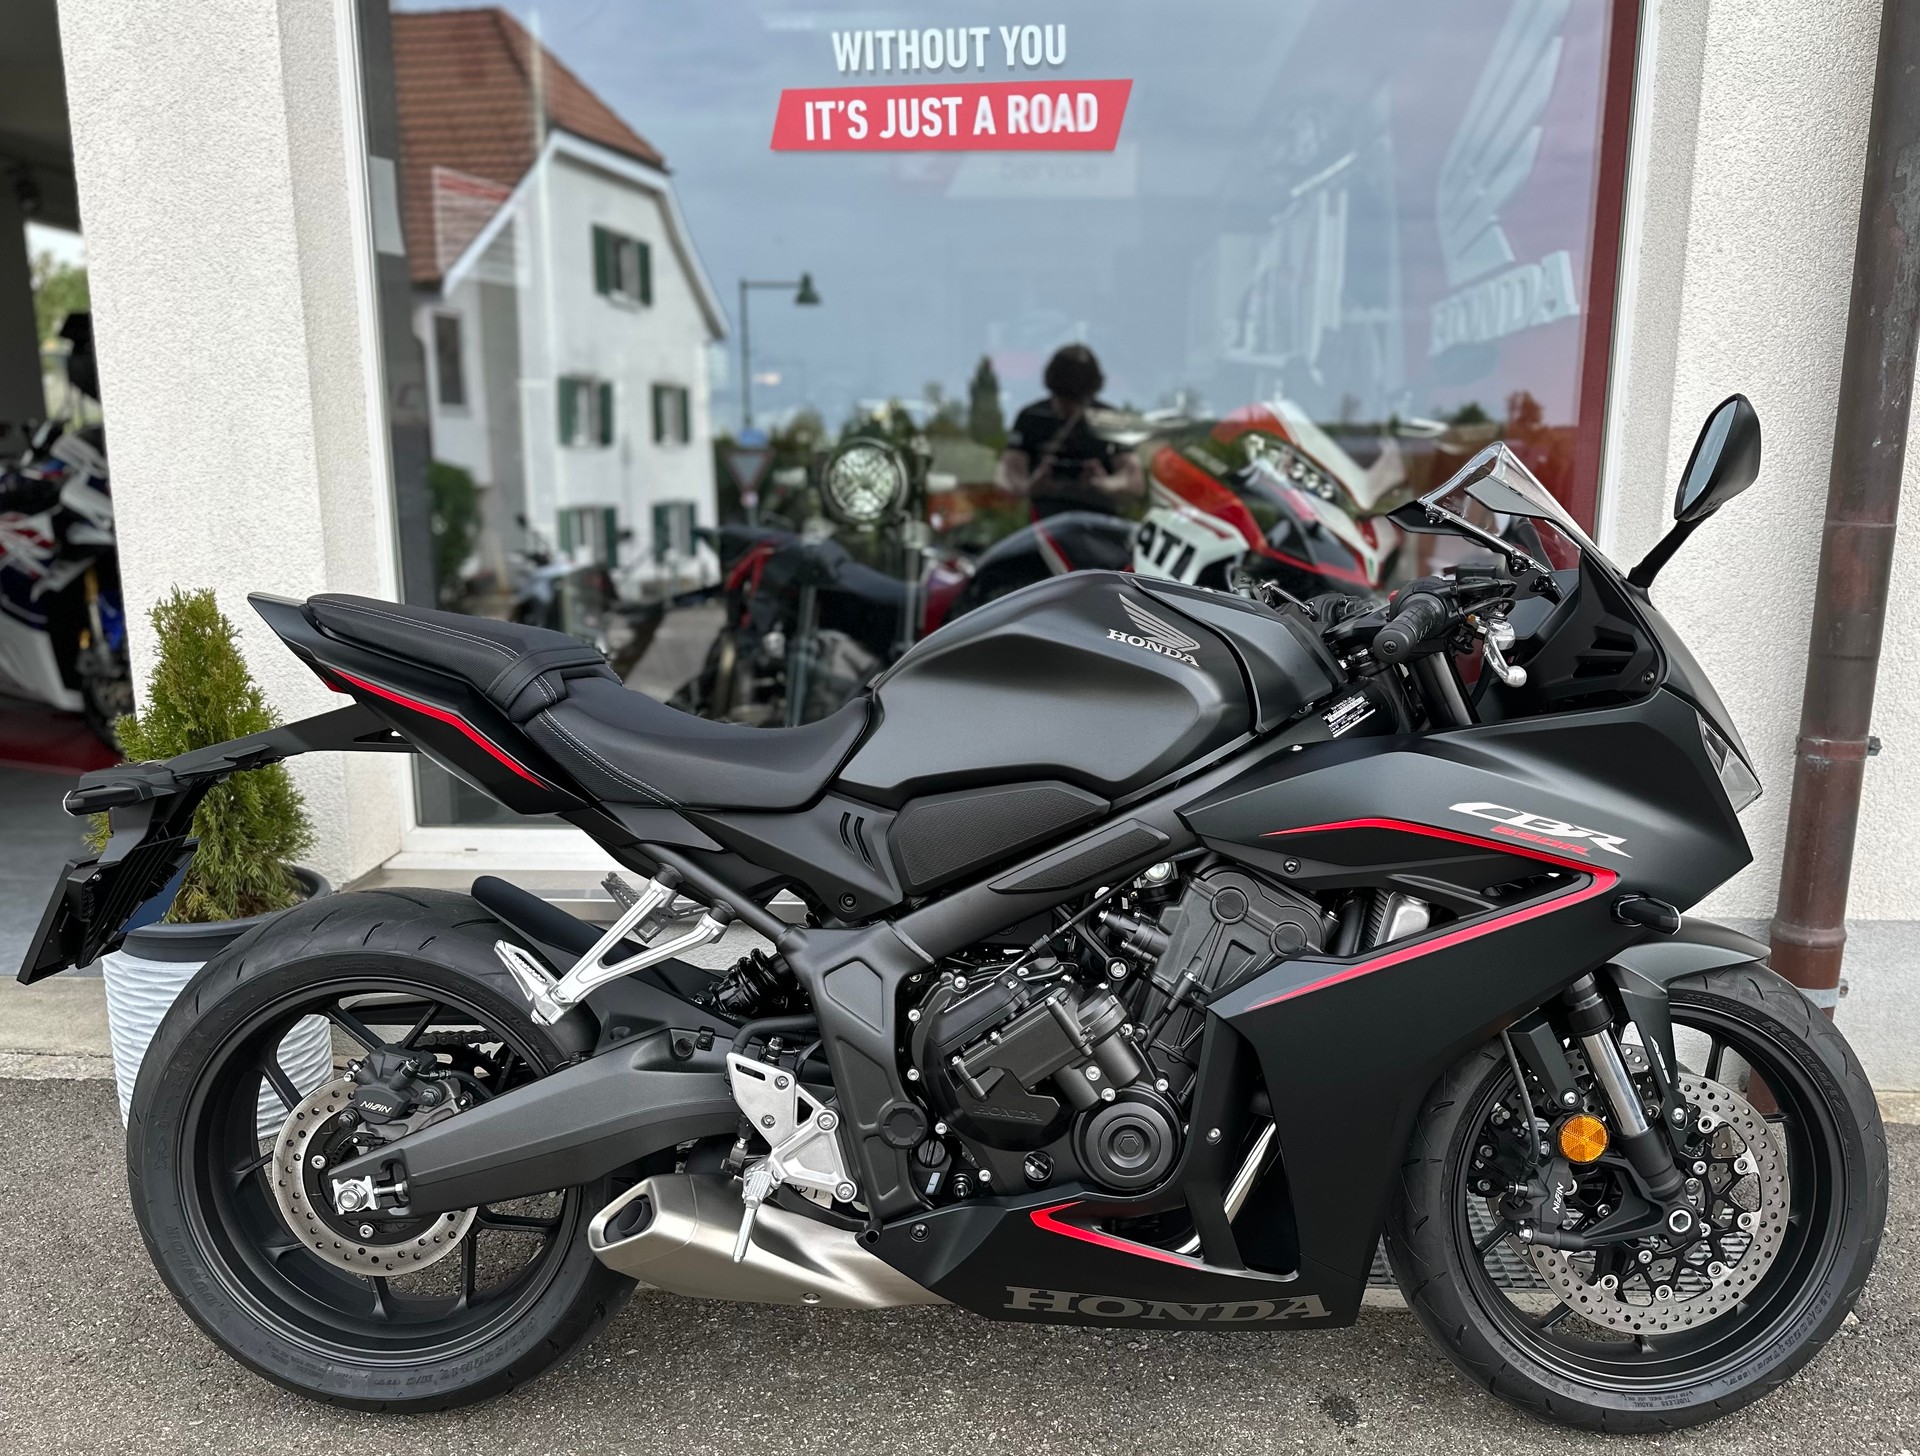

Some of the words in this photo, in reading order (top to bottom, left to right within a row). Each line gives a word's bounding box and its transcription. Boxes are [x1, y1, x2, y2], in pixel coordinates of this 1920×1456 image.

[832, 26, 991, 72] WITHOUT
[999, 24, 1067, 66] YOU
[804, 100, 869, 141] IT'S
[879, 96, 963, 139] JUST
[973, 95, 996, 136] A
[1007, 92, 1099, 134] ROAD
[1106, 628, 1200, 667] HONDA
[1448, 802, 1633, 858] CBR
[1490, 825, 1592, 857] 650R
[359, 1100, 393, 1114] NISSIN
[974, 1105, 1043, 1122] HONDA
[1552, 1181, 1565, 1215] NISSIN
[1003, 1286, 1332, 1323] HONDA
